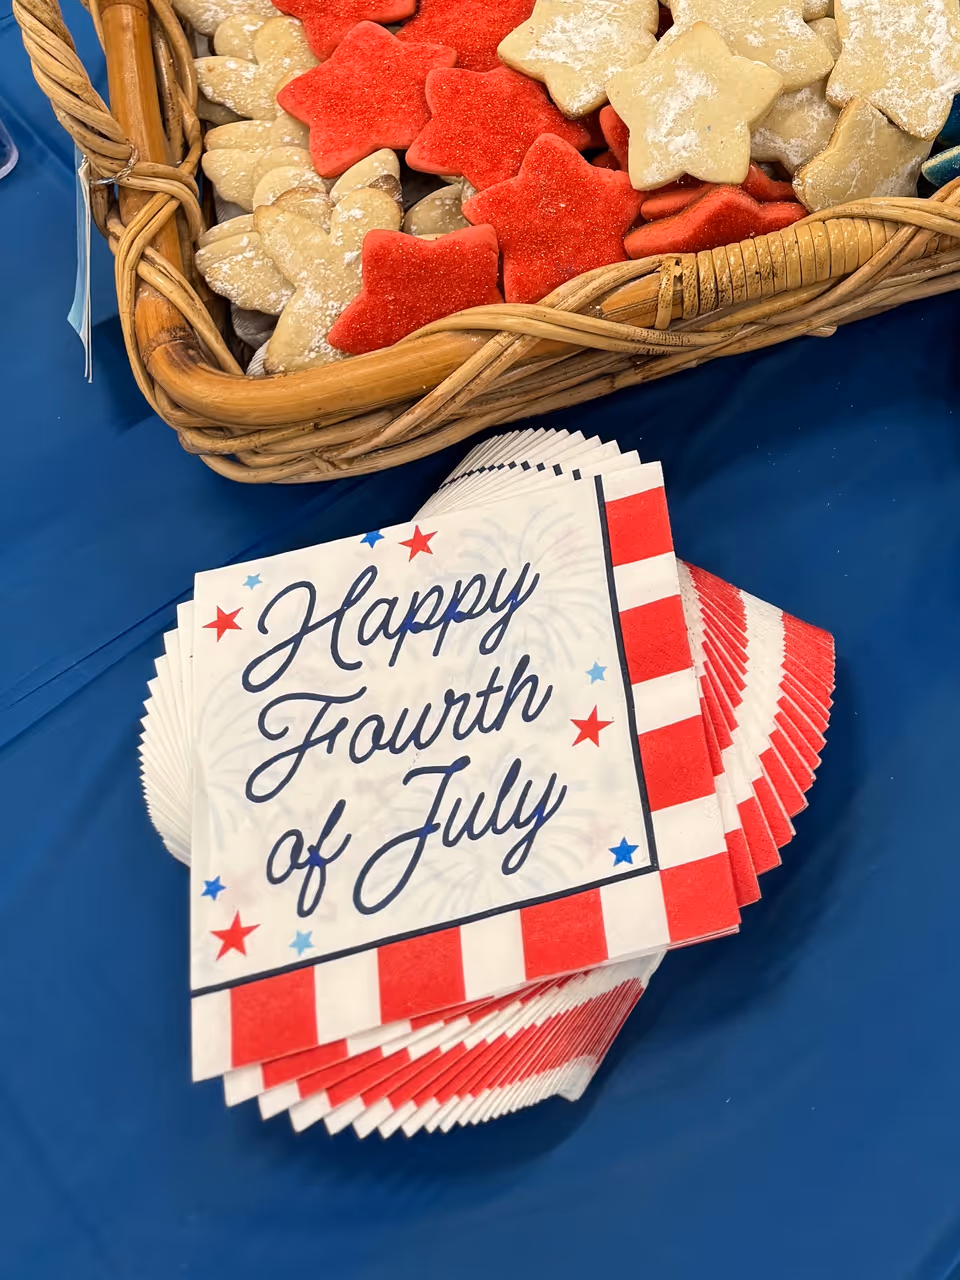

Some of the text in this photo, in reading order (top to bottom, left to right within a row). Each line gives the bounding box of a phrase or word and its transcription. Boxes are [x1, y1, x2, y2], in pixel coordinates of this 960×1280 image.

[241, 562, 540, 693] Happy
[244, 654, 553, 803] Fourth
[265, 755, 568, 918] of July
